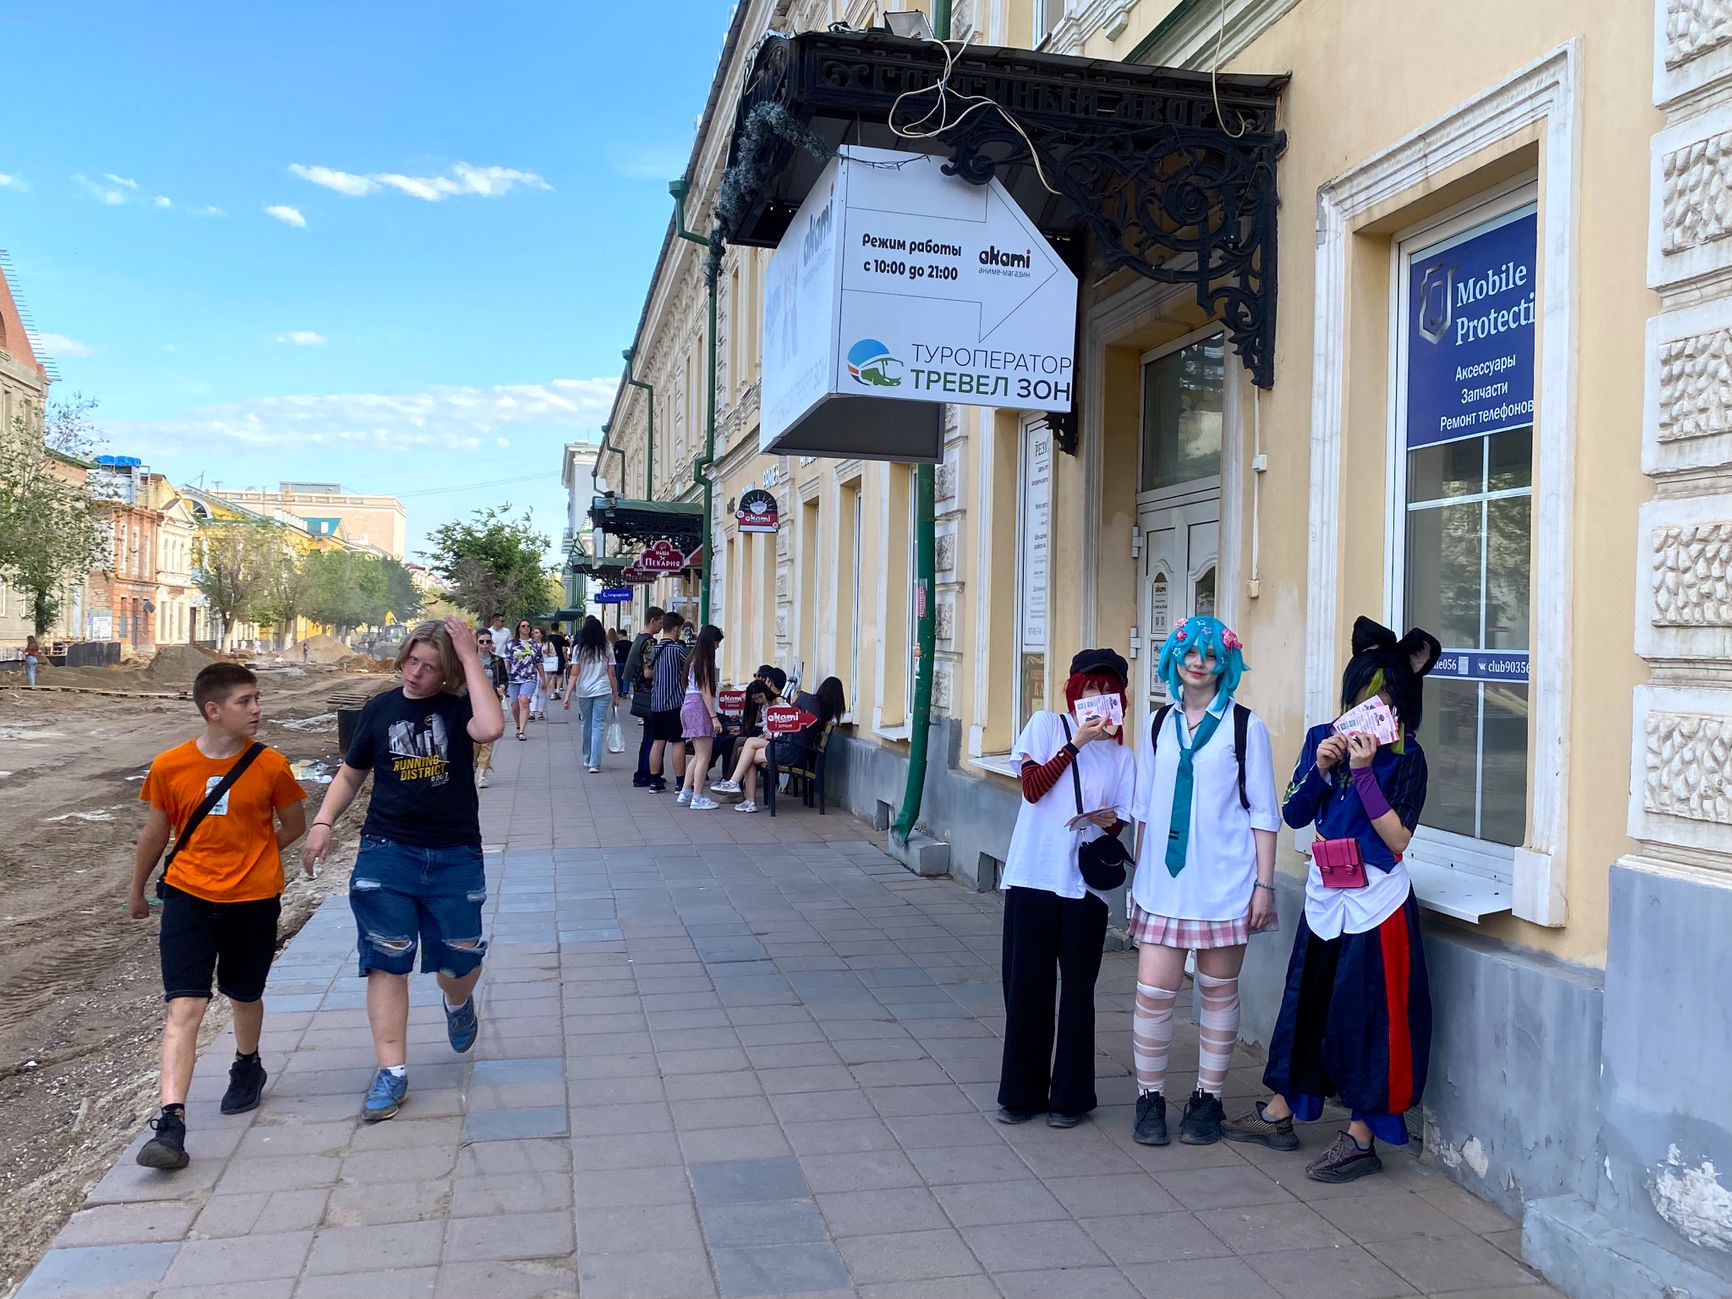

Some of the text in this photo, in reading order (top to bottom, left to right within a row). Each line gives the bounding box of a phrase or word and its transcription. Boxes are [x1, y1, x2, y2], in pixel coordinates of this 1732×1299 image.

[862, 233, 962, 257] Режим работы
[979, 246, 1031, 269] akami
[874, 259, 906, 276] 10:00
[927, 264, 958, 281] 21:00
[978, 266, 1031, 279] аниме-магазин
[1456, 262, 1527, 307] Mobile
[1455, 292, 1535, 346] Protecti
[911, 343, 1072, 375] ТУРОПЕРАТОР
[1455, 354, 1516, 382] Аксессуары
[910, 368, 1071, 402] ТРЕВЕЛ ЗОН
[1461, 381, 1508, 404] Запчасти
[1440, 399, 1534, 431] Ремонт телефонов
[768, 711, 798, 721] akami
[393, 755, 439, 771] RUNNING
[400, 762, 447, 781] DISTRICT
